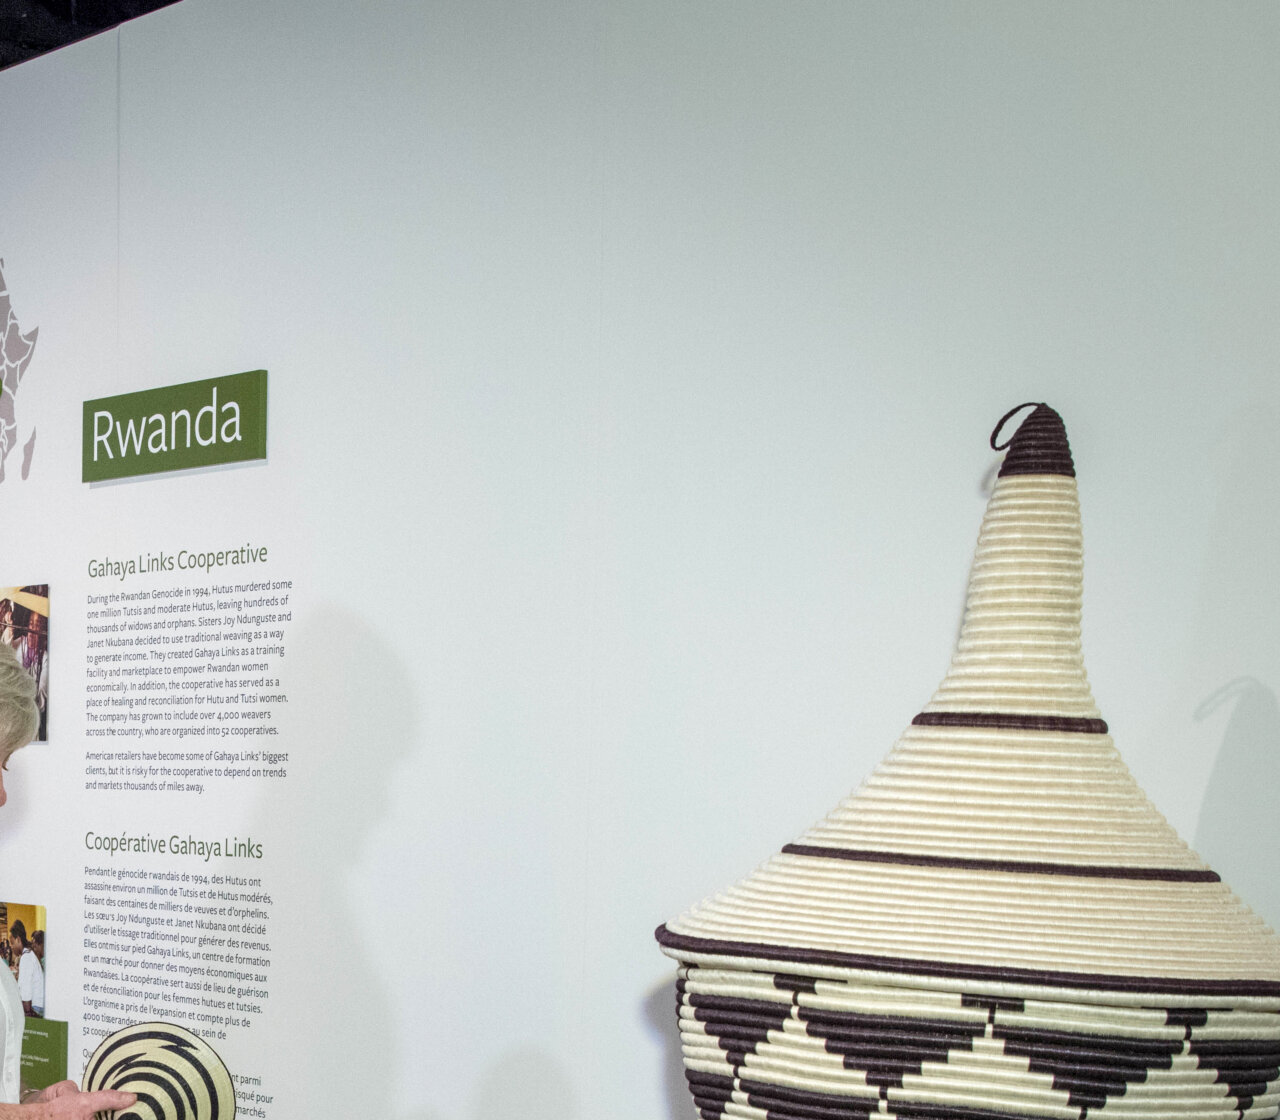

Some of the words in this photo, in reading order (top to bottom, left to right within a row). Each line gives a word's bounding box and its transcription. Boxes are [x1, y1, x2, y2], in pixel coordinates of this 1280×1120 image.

[93, 388, 242, 462] Rwanda
[88, 557, 136, 581] Gahaya
[139, 552, 174, 573] Links
[177, 546, 268, 573] Cooperative
[87, 595, 108, 606] During
[109, 593, 120, 602] the
[121, 590, 150, 601] Rwandan
[152, 587, 183, 599] Genocide
[184, 586, 191, 596] in
[212, 585, 233, 594] Hutus
[234, 580, 271, 592] murdered
[272, 581, 293, 590] some
[100, 608, 121, 617] million
[122, 606, 142, 616] Tutsis
[143, 605, 156, 615] and
[157, 603, 191, 614] moderate
[192, 602, 216, 611] Hutus,
[217, 598, 242, 612] leaving
[243, 596, 279, 608] hundreds
[280, 594, 289, 606] of
[87, 623, 119, 634] thousands
[119, 621, 127, 632] of
[128, 621, 152, 631] widows
[153, 619, 166, 630] and
[167, 618, 197, 631] orphans.
[198, 616, 222, 627] Sisters
[223, 616, 236, 628] Joy
[236, 614, 277, 626] Ndunguste
[277, 610, 292, 622] and
[105, 637, 134, 647] Nkubana
[134, 635, 161, 646] decided
[162, 636, 170, 644] to
[171, 635, 184, 644] use
[184, 631, 222, 643] traditional
[223, 630, 253, 643] weaving
[253, 631, 262, 640] as
[263, 631, 268, 639] a
[269, 630, 284, 641] way
[86, 655, 94, 663] to
[94, 654, 122, 666] generate
[149, 650, 166, 662] They
[167, 648, 193, 659] created
[194, 648, 220, 660] Gahaya
[221, 646, 240, 657] Links
[241, 648, 249, 656] as
[250, 647, 255, 656] a
[256, 644, 285, 658] training
[109, 667, 121, 677] and
[122, 666, 163, 678] marketplace
[164, 666, 172, 675] to
[172, 665, 206, 676] empower
[207, 662, 240, 673] Rwandan
[241, 663, 269, 672] women
[86, 682, 128, 694] economically.
[130, 682, 137, 690] In
[138, 680, 168, 691] addition,
[168, 680, 180, 690] the
[181, 678, 224, 691] cooperative
[225, 678, 238, 688] has
[239, 677, 264, 688] served
[265, 679, 274, 687] as
[275, 678, 280, 687] a
[85, 831, 166, 856] Coopérative
[169, 835, 222, 862] Gahaya
[225, 838, 263, 859] Links
[117, 868, 148, 880] génocide
[149, 871, 180, 882] rwandais
[180, 872, 190, 882] de
[191, 875, 210, 885] 1994,
[211, 874, 224, 885] des
[225, 875, 247, 886] Hutus
[248, 878, 262, 887] ont
[106, 897, 116, 907] des
[117, 899, 148, 909] centaines
[148, 900, 157, 910] de
[158, 901, 183, 912] milliers
[184, 903, 193, 913] de
[194, 906, 218, 915] veuves
[218, 907, 226, 916] et
[112, 885, 136, 893] environ
[146, 885, 168, 896] million
[169, 887, 178, 897] de
[178, 887, 198, 898] Tutsis
[199, 890, 207, 899] et
[207, 889, 217, 900] de
[217, 890, 239, 901] Hutus
[239, 892, 273, 906] modérés,
[84, 911, 95, 920] Les
[116, 913, 128, 925] Joy
[128, 914, 165, 928] Ndunguste
[166, 918, 173, 927] et
[174, 918, 194, 928] Janet
[195, 919, 227, 932] Nkubana
[227, 924, 240, 933] ont
[241, 923, 267, 935] décidé
[110, 926, 116, 936] le
[117, 927, 140, 941] tissage
[140, 930, 180, 942] traditionnel
[180, 935, 197, 945] pour
[198, 934, 226, 948] générer
[226, 937, 240, 949] des
[240, 941, 272, 952] revenus.
[202, 1030, 216, 1040] sein
[217, 1030, 226, 1040] de
[240, 1074, 262, 1086] parmi
